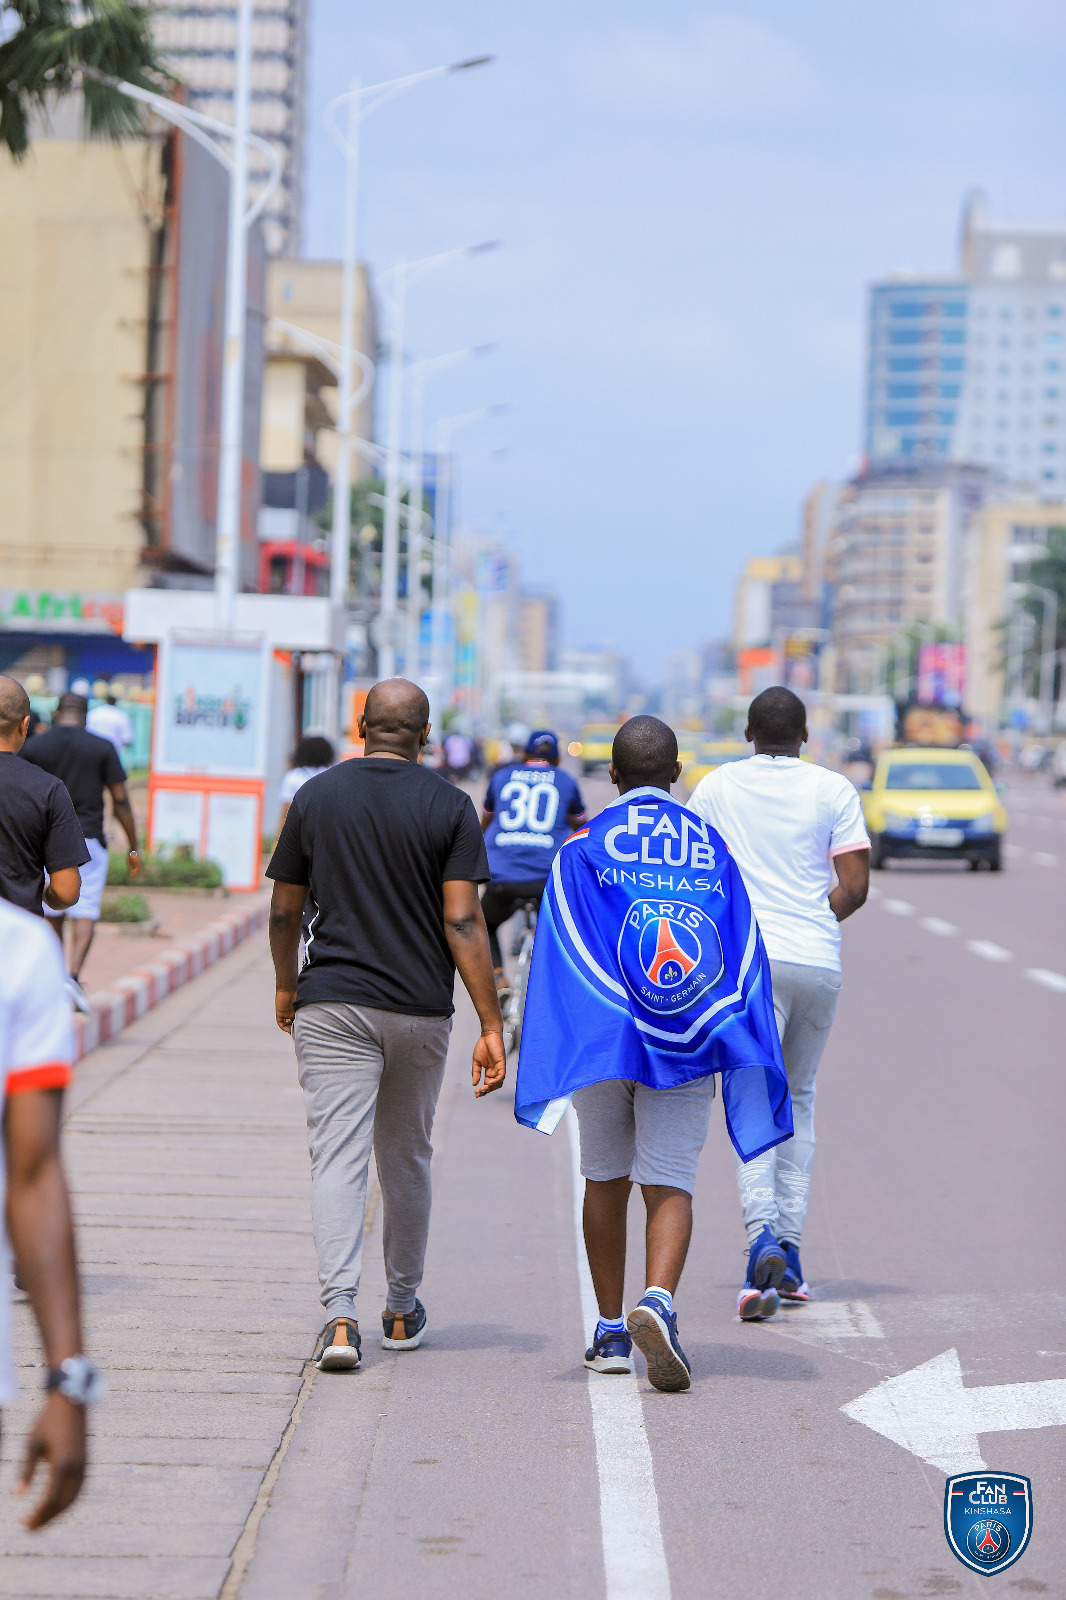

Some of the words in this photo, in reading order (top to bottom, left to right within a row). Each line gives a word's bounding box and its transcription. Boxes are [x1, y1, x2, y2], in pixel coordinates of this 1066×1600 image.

[499, 780, 560, 833] 30
[628, 804, 710, 844] FAN
[604, 824, 716, 871] CLUB
[596, 867, 726, 899] KINSHASA
[629, 903, 704, 930] PARIS
